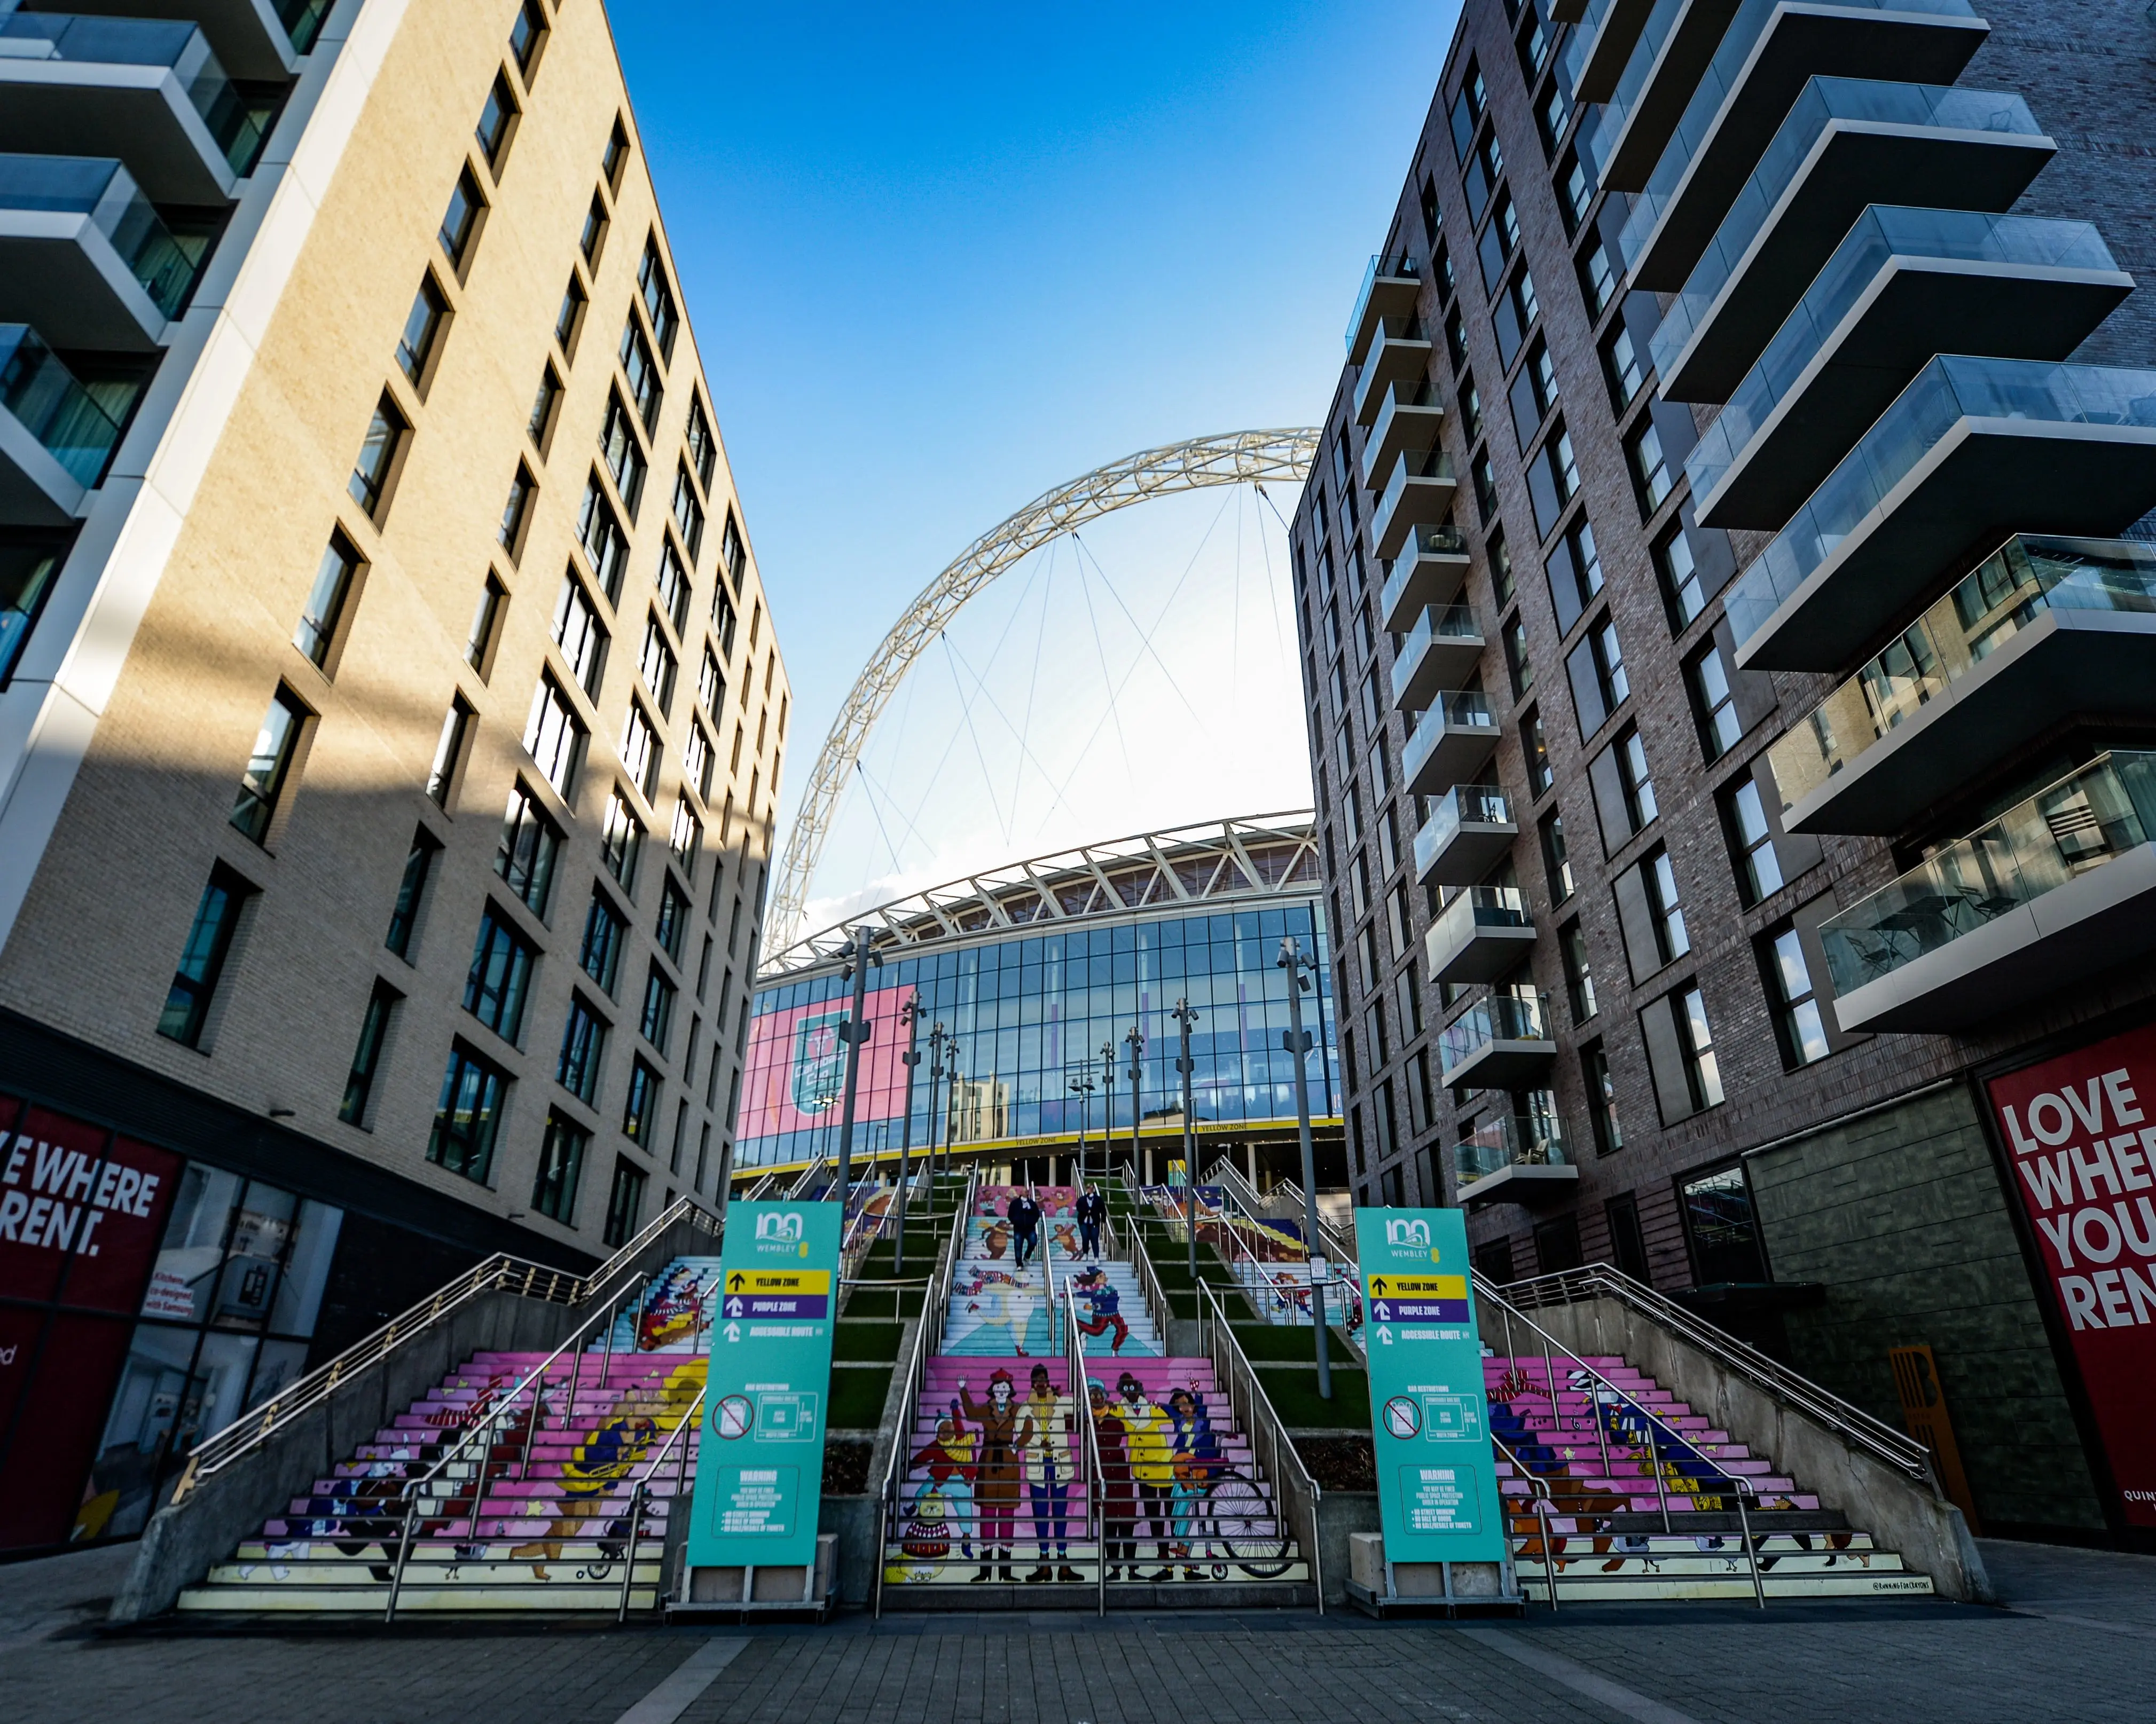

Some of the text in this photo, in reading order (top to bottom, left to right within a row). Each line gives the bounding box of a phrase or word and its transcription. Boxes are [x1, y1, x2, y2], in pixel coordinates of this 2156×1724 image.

[795, 1050, 843, 1078] Carabao
[806, 1069, 828, 1085] Cup
[2002, 1067, 2145, 1155] LOVE
[30, 1140, 160, 1218] WHERE
[757, 1244, 796, 1253] WEMBLEY
[1391, 1249, 1427, 1257] WEMBLEY
[756, 1278, 799, 1287] YELLOW ZONE
[1397, 1282, 1438, 1291] YELLOW ZONE
[146, 1301, 161, 1309] with
[752, 1301, 797, 1312] PURPLE ZONE
[1399, 1305, 1440, 1316] PURPLE ZONE
[749, 1326, 813, 1337] ACCESSIBLE ROUTE
[1401, 1330, 1461, 1340] ACCESSIBLE ROUTE
[740, 1470, 777, 1482] WARNING
[1420, 1469, 1455, 1481] WARNING
[2123, 1490, 2156, 1502] QUIN
